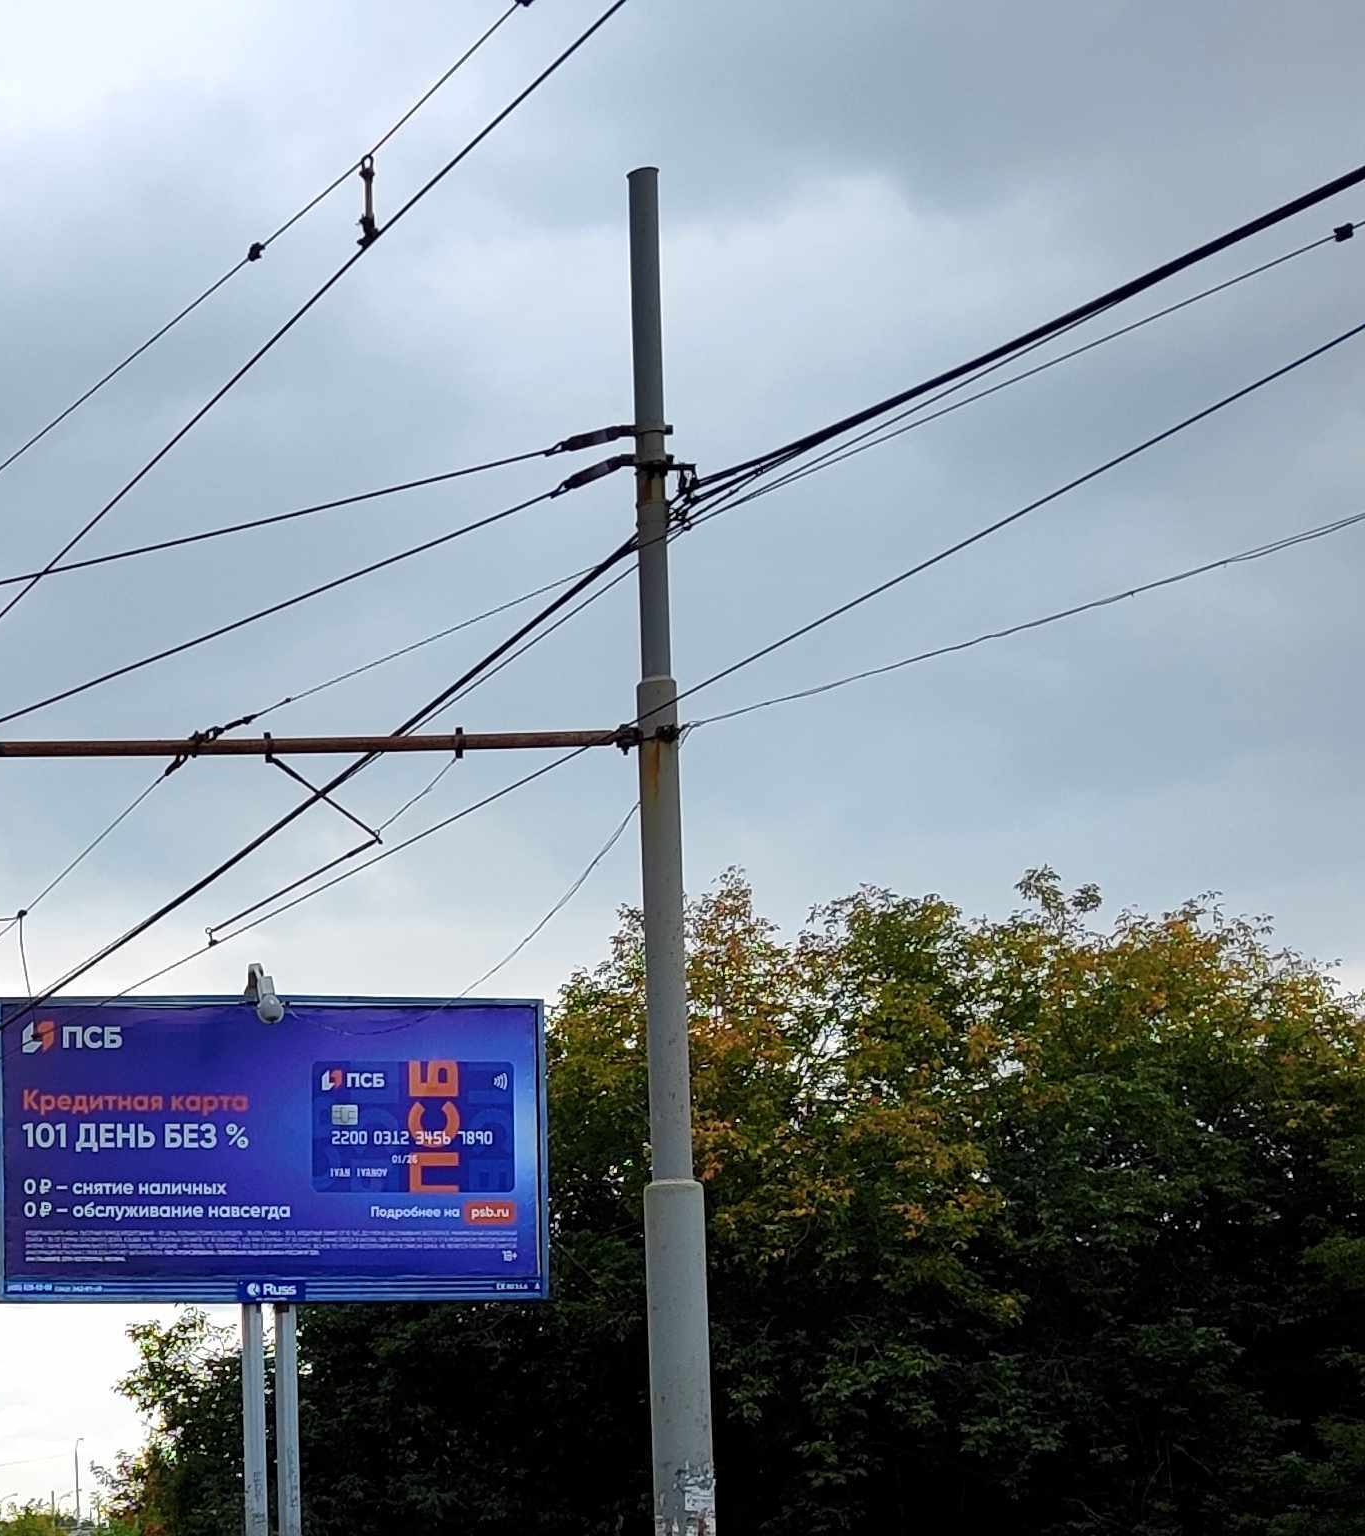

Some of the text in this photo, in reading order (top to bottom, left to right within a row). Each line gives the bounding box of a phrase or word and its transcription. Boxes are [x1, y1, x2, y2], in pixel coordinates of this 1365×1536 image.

[62, 1026, 124, 1049] ПСБ
[346, 1072, 385, 1088] ПСБ
[22, 1089, 250, 1115] Кредитная карта
[408, 1060, 460, 1194] ПСБ
[22, 1122, 250, 1152] 101 ДЕНЬ БЕЗ %
[331, 1130, 493, 1145] 2200 0312 3456 7890
[330, 1168, 388, 1177] IVAN IVANOV
[72, 1180, 135, 1195] снятие
[138, 1181, 227, 1195] наличных
[72, 1203, 204, 1221] обслуживание
[208, 1204, 291, 1220] навсегда
[370, 1206, 510, 1219] Подробнее на psb.ru
[262, 1283, 297, 1296] Russ
